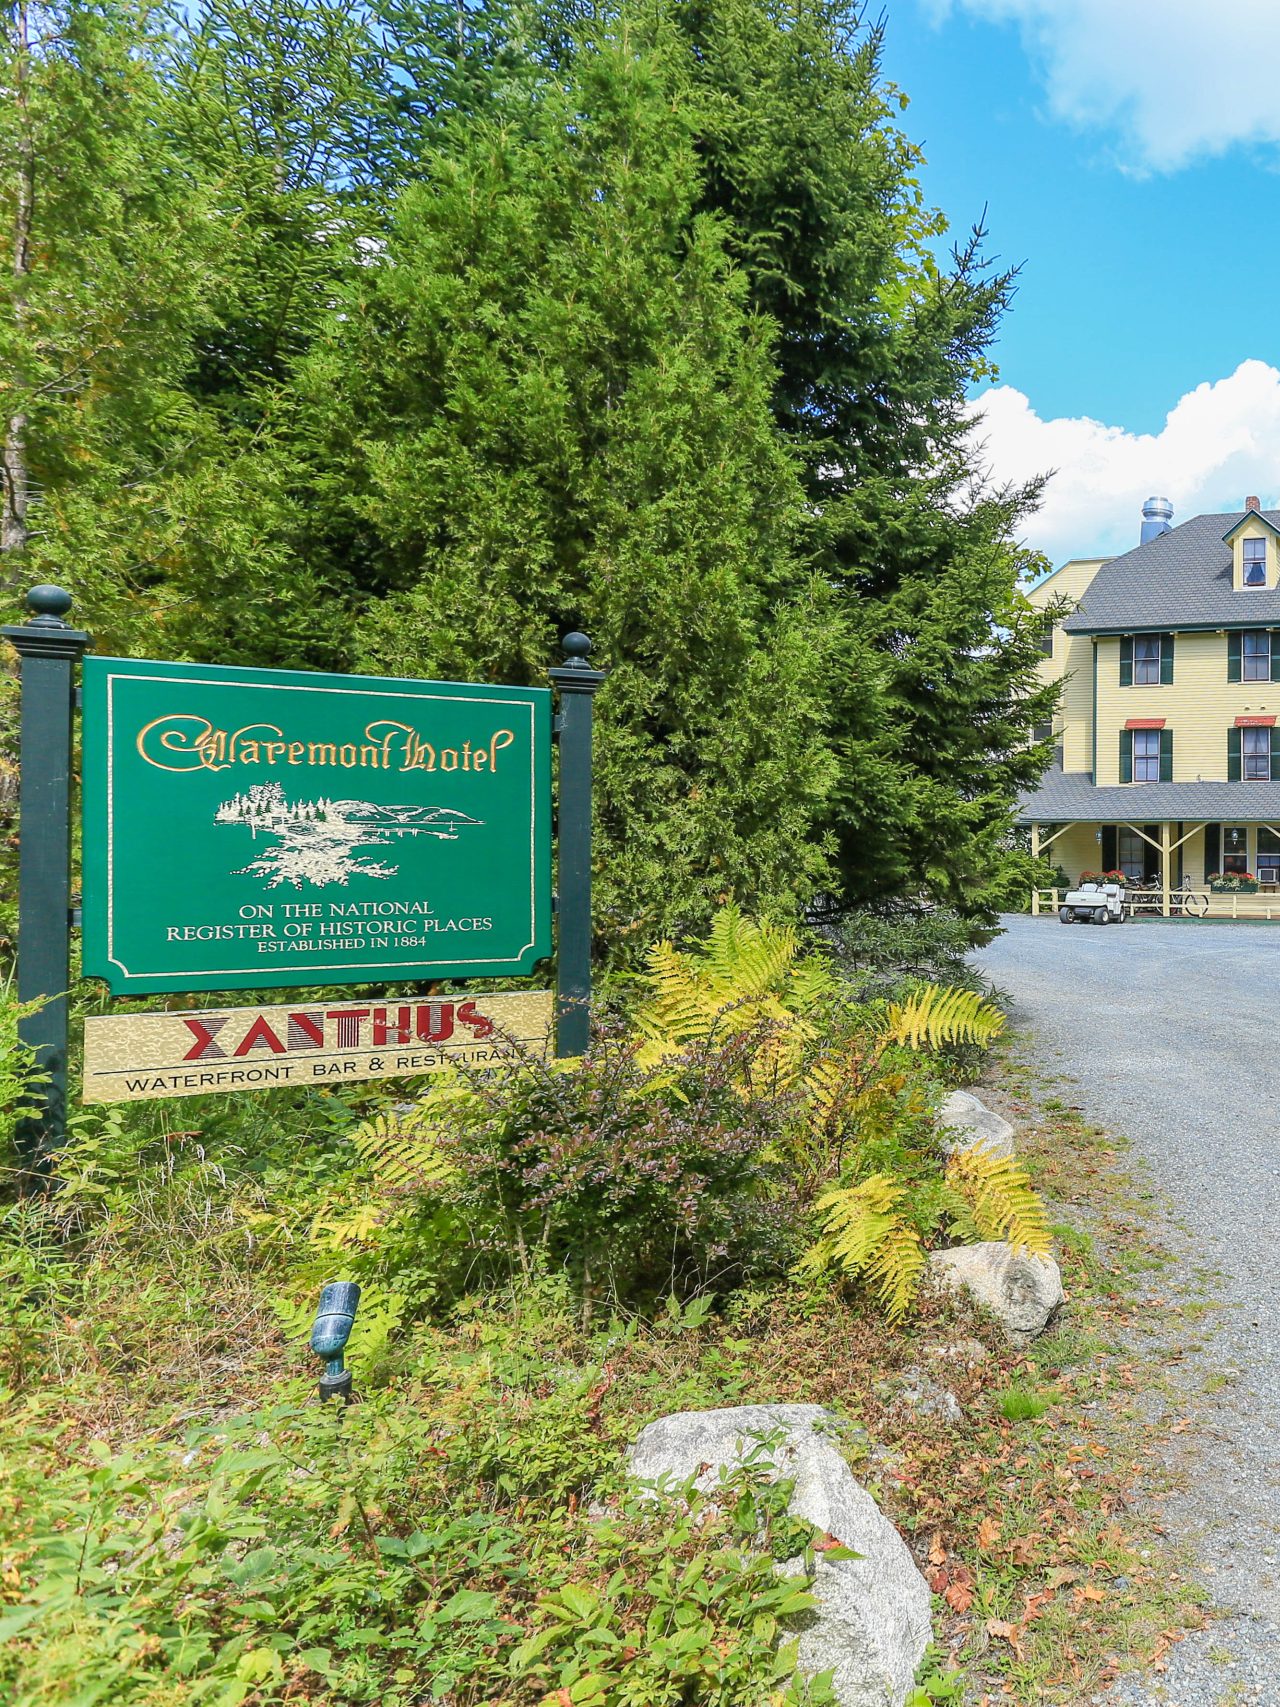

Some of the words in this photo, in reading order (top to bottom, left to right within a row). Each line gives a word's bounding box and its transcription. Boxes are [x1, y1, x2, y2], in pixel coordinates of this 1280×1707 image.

[136, 713, 399, 772] Claremont
[365, 719, 514, 773] Hotel
[239, 904, 274, 919] ON
[280, 903, 323, 918] THE
[329, 901, 434, 917] NATIONAL
[166, 924, 277, 941] REGISTER
[283, 922, 312, 937] OF
[319, 919, 417, 936] HISTORIC
[423, 917, 492, 932] PLACES
[257, 938, 366, 953] ESTABLISHED
[370, 937, 388, 948] IN
[394, 936, 426, 947] 1884
[182, 1001, 494, 1061] XANTHUS
[125, 1066, 294, 1092] WATERFRONT
[313, 1061, 357, 1076] BAR
[369, 1057, 385, 1071] &
[397, 1049, 517, 1069] RESTURAN
